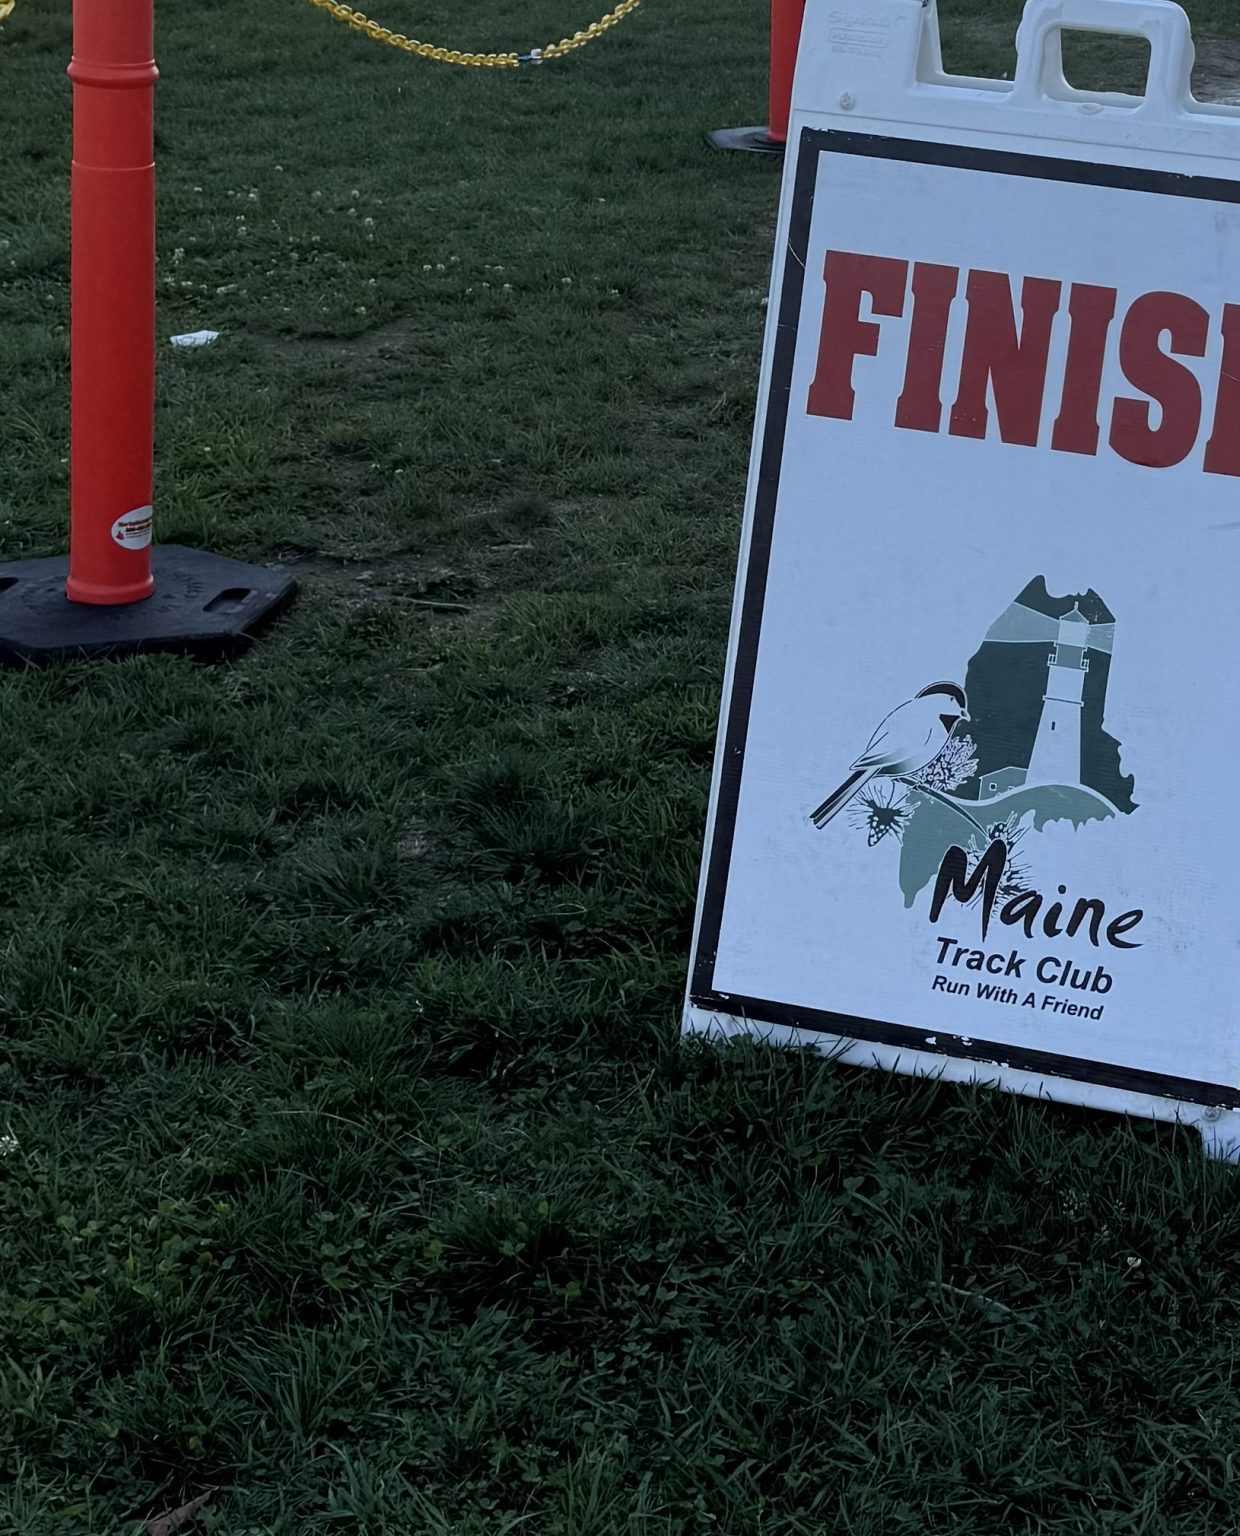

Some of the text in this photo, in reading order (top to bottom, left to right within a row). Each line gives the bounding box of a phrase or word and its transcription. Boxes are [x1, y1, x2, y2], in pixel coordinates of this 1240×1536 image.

[929, 838, 1144, 949] Maine
[936, 936, 1113, 994] Track Club
[932, 975, 1104, 1021] Run With A Friend
